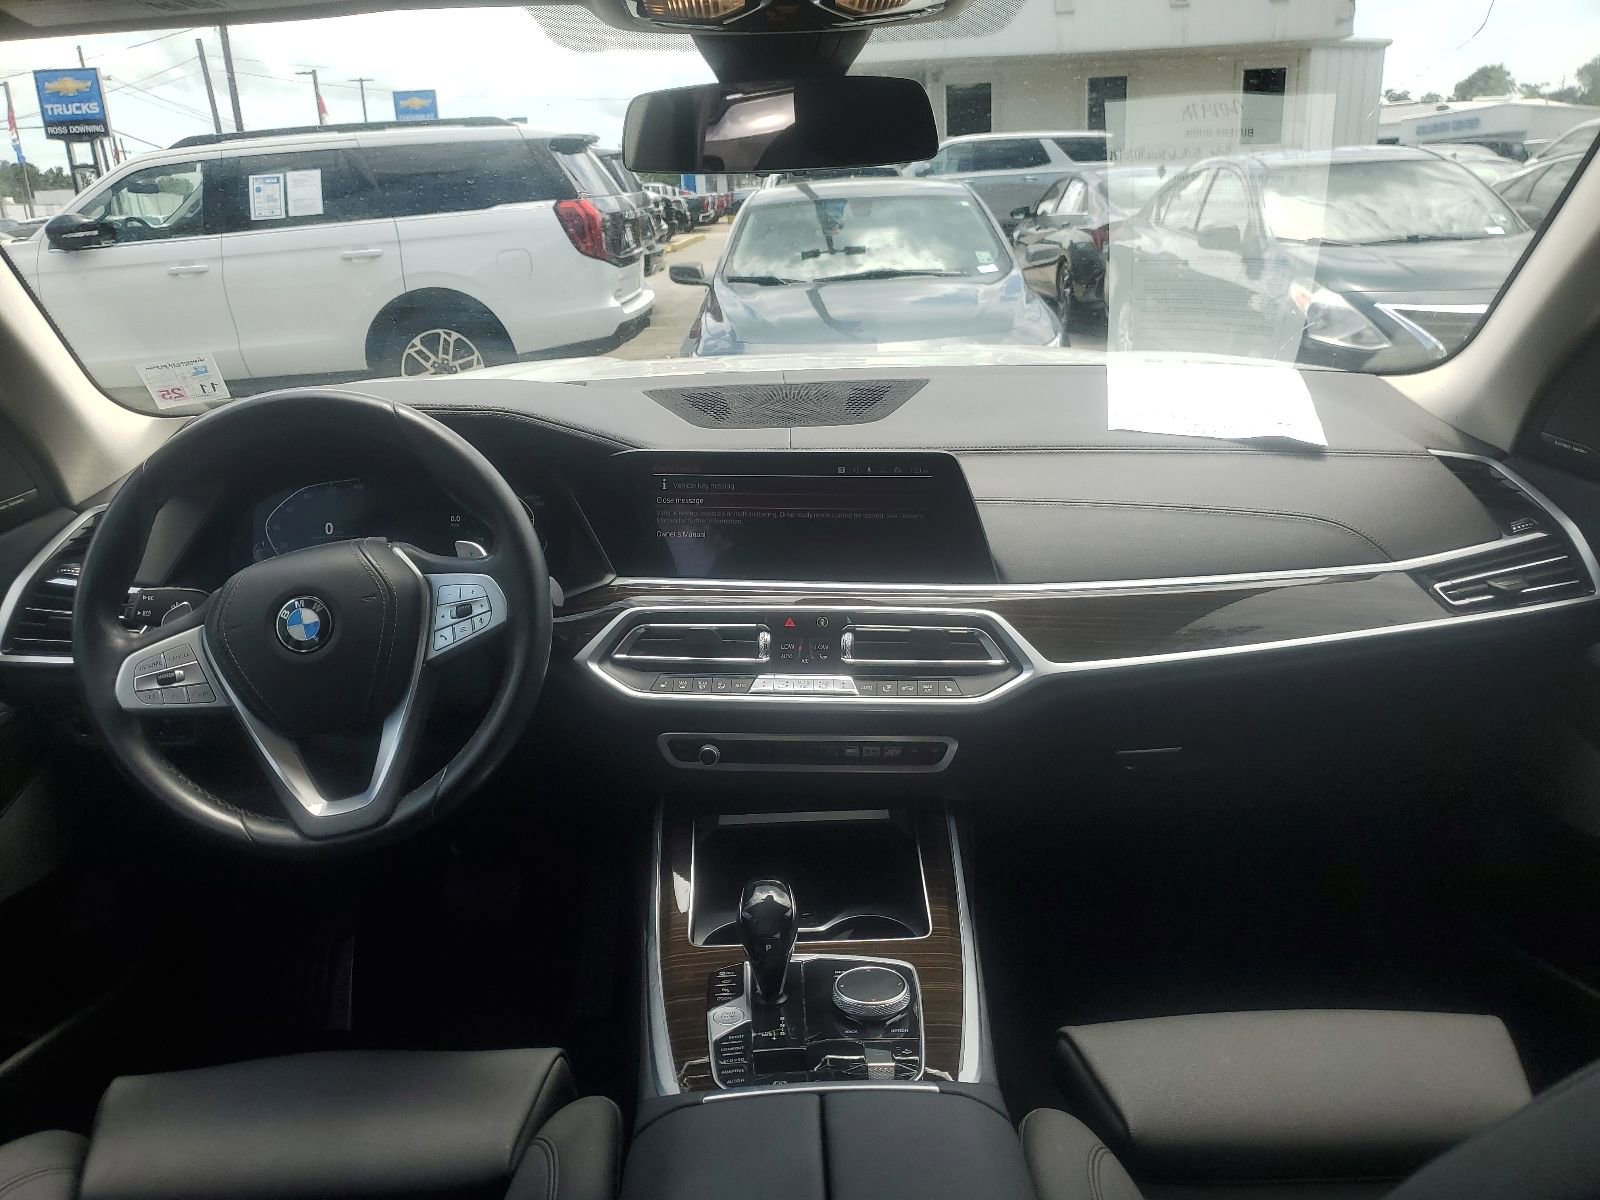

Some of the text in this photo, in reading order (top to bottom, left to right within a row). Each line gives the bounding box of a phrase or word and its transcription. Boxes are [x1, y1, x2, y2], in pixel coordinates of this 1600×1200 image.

[44, 102, 100, 116] TRUCKS
[47, 124, 105, 135] ROSS DOWNING
[656, 496, 674, 504] Close
[324, 521, 334, 536] 0
[682, 530, 706, 539] Manual
[281, 600, 324, 620] BMW
[765, 944, 772, 952] P
